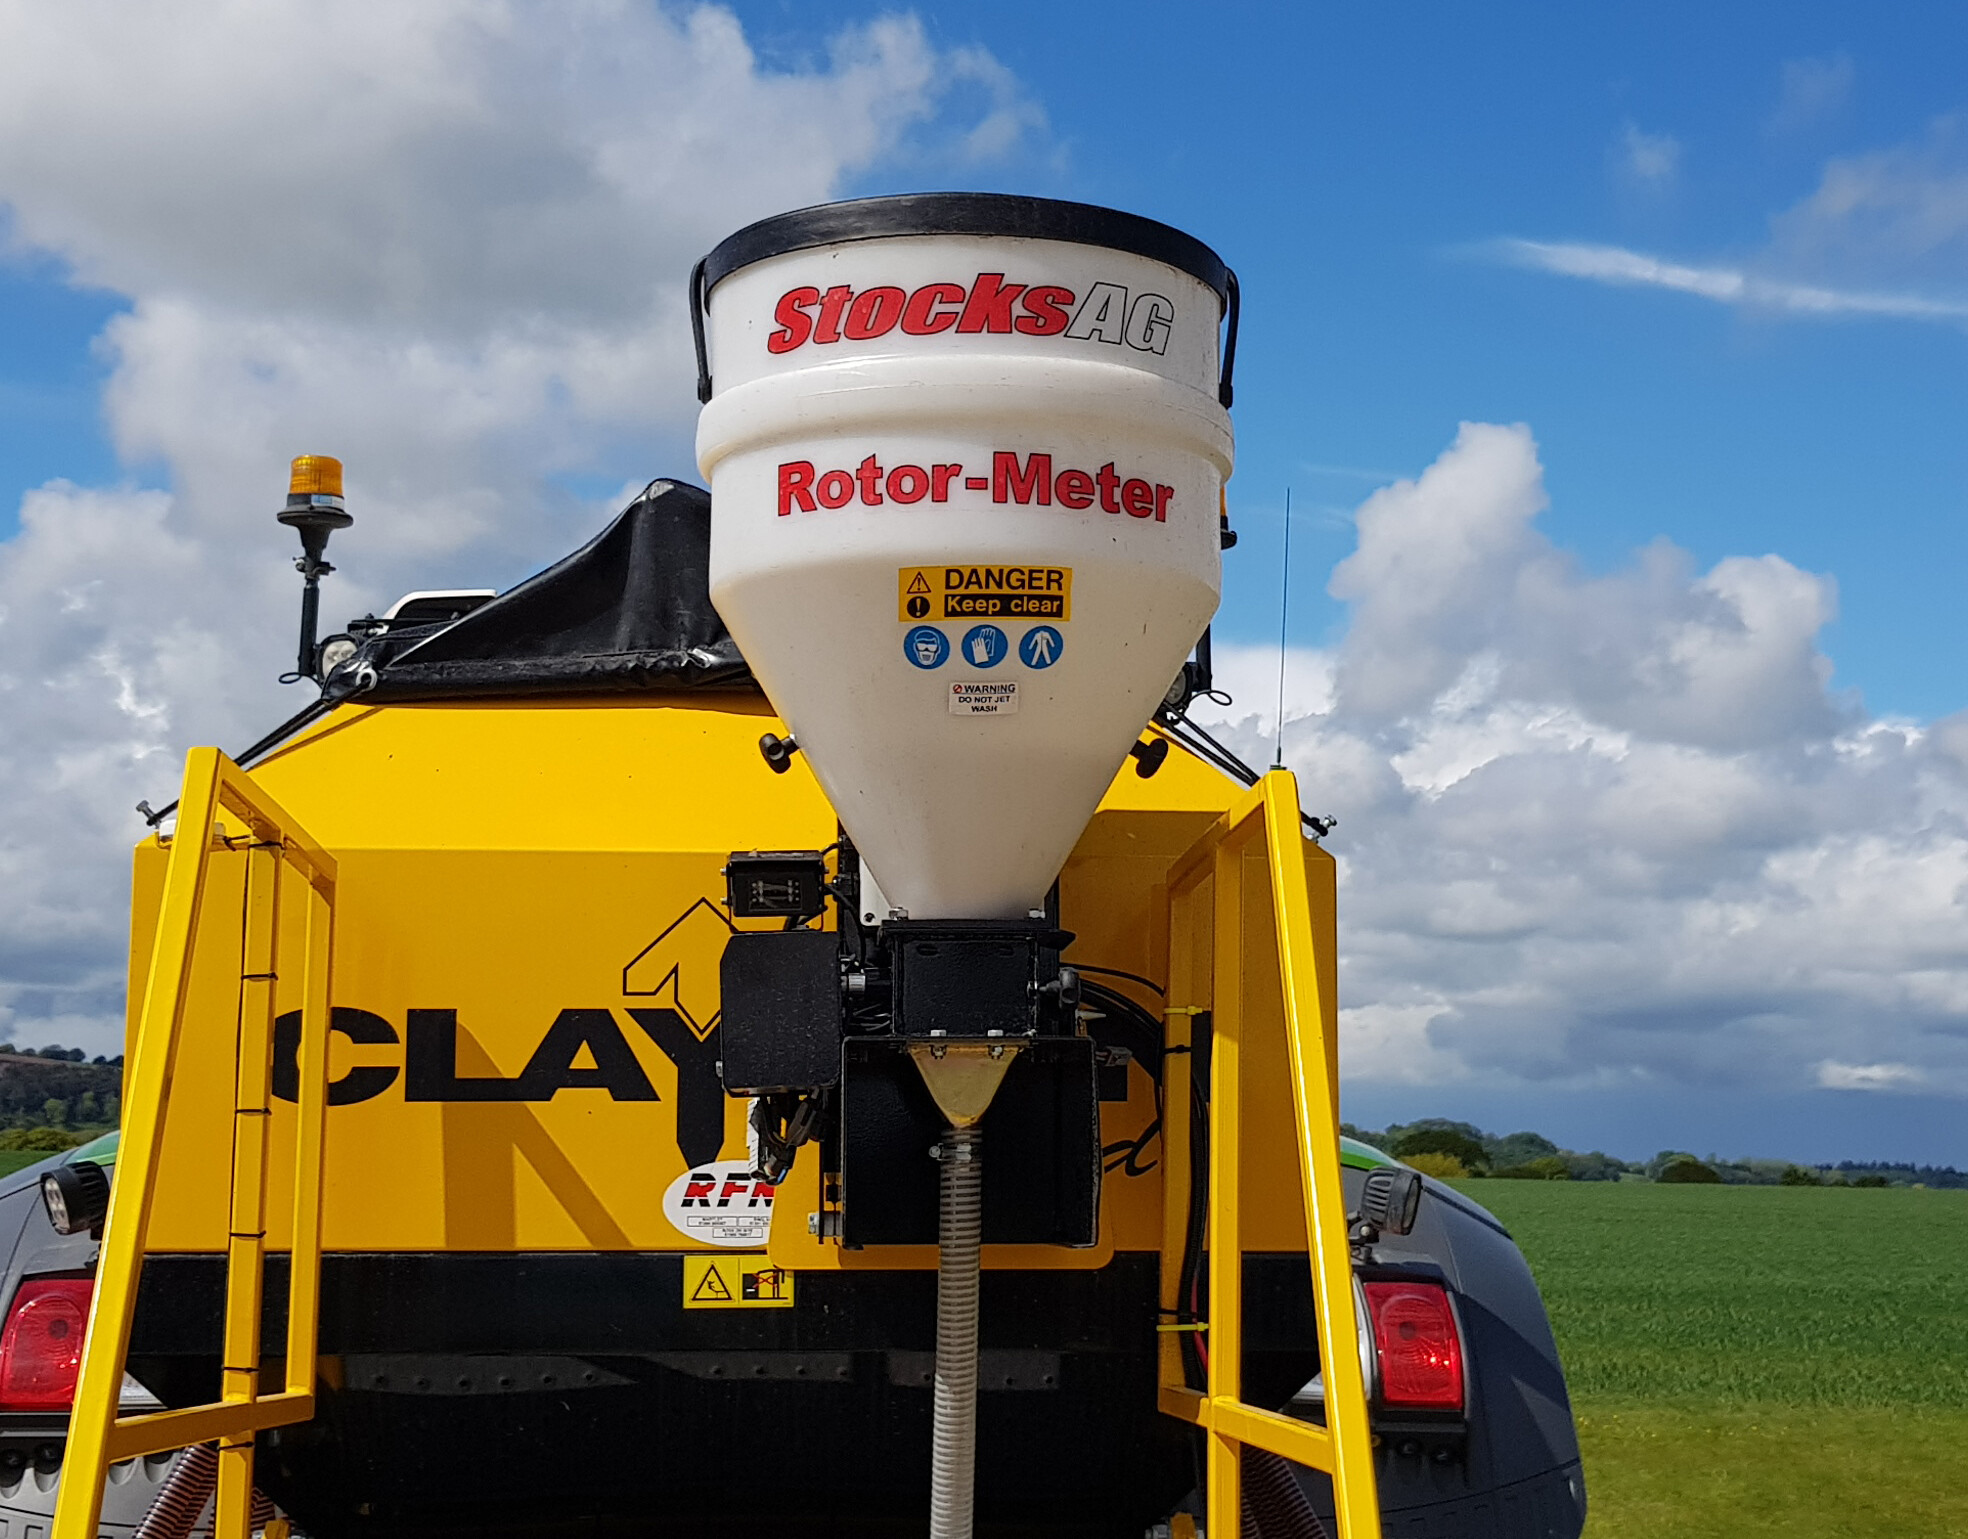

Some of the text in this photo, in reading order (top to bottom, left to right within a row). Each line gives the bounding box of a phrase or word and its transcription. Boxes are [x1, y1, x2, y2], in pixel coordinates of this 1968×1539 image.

[777, 451, 1175, 522] Rotor-Meter
[944, 567, 1065, 592] DANGER
[947, 595, 1061, 616] Keep clear
[964, 683, 1016, 695] WARNING
[958, 695, 1011, 704] DO NOT JET
[971, 705, 998, 713] WASH
